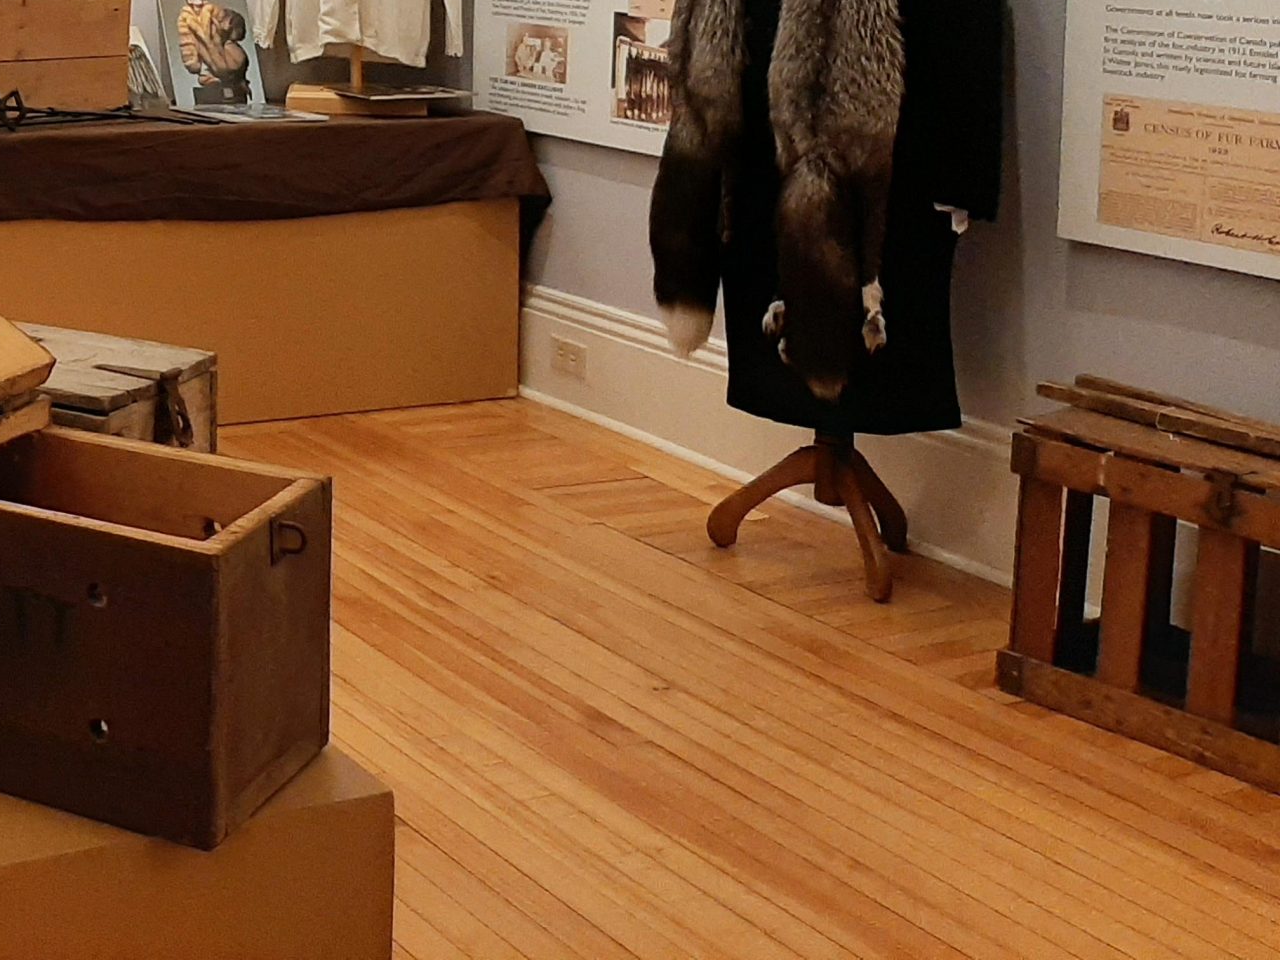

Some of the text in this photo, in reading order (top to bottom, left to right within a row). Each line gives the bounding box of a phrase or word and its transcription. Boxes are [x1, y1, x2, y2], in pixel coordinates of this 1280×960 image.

[1143, 122, 1192, 139] CENSUS
[1195, 128, 1213, 141] OF
[1217, 131, 1243, 145] FUR
